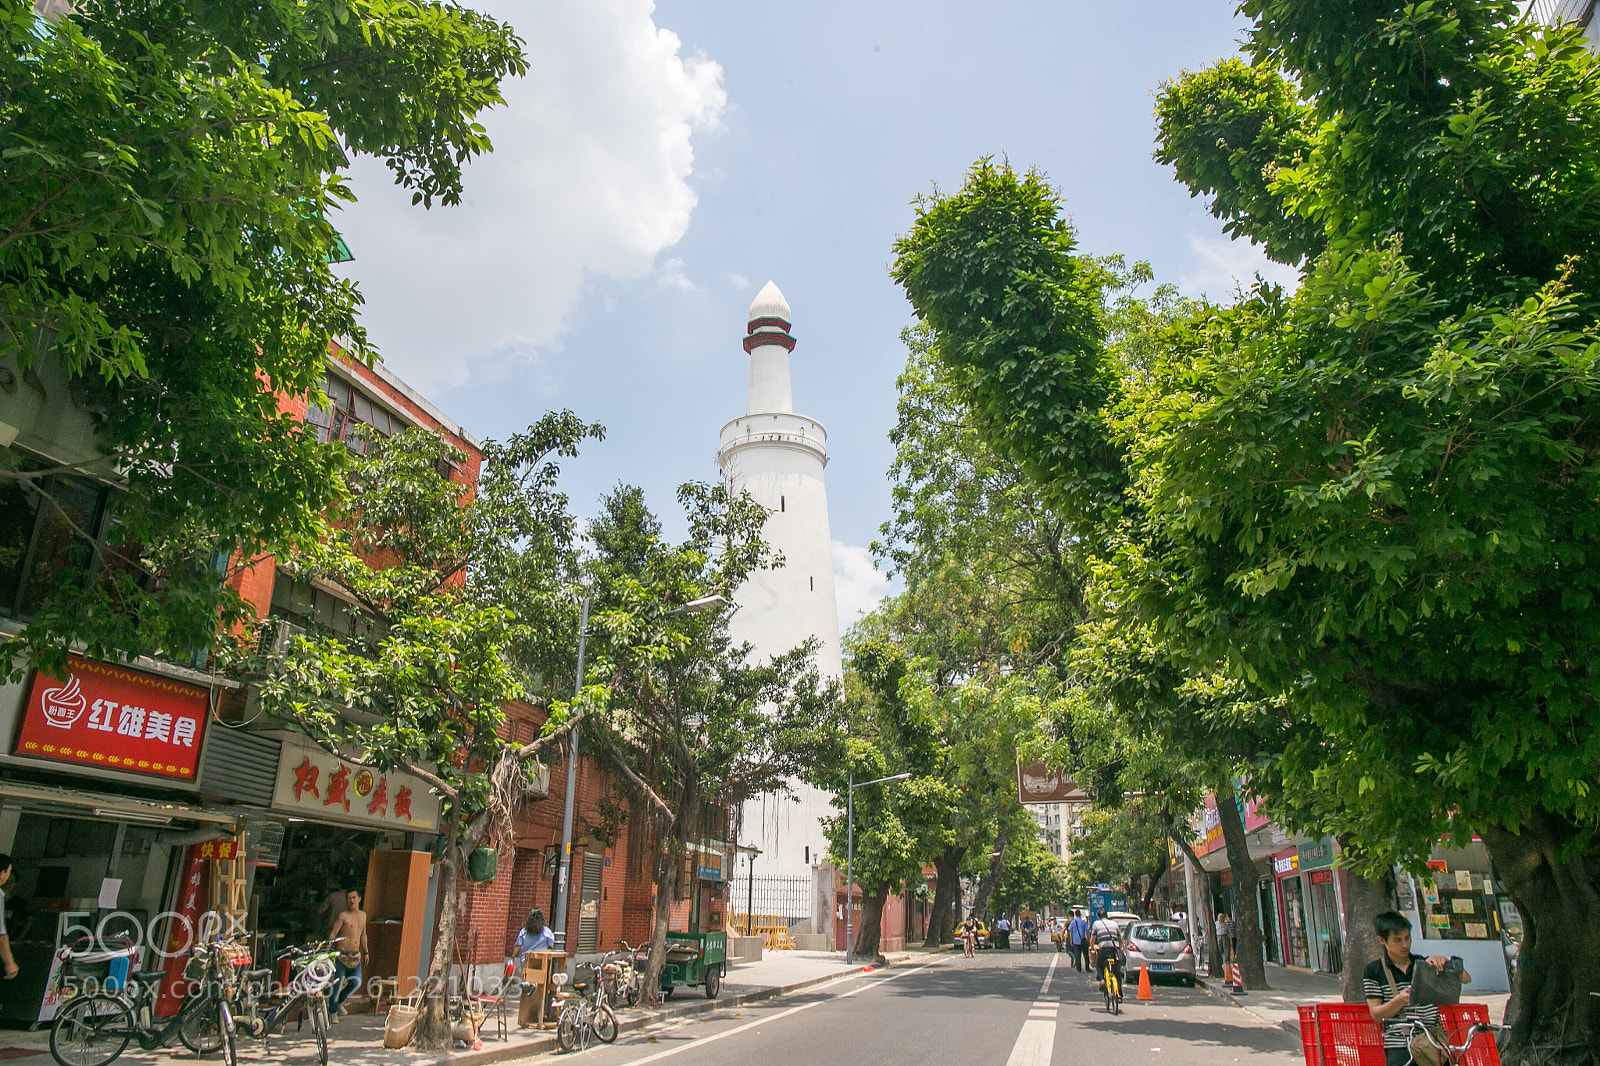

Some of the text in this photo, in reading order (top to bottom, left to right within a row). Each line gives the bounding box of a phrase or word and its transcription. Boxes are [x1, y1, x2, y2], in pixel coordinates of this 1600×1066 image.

[48, 705, 76, 719] 粉面王
[87, 699, 196, 748] 红雄美食
[200, 841, 232, 859] 快餐
[181, 858, 204, 932] 雄美食
